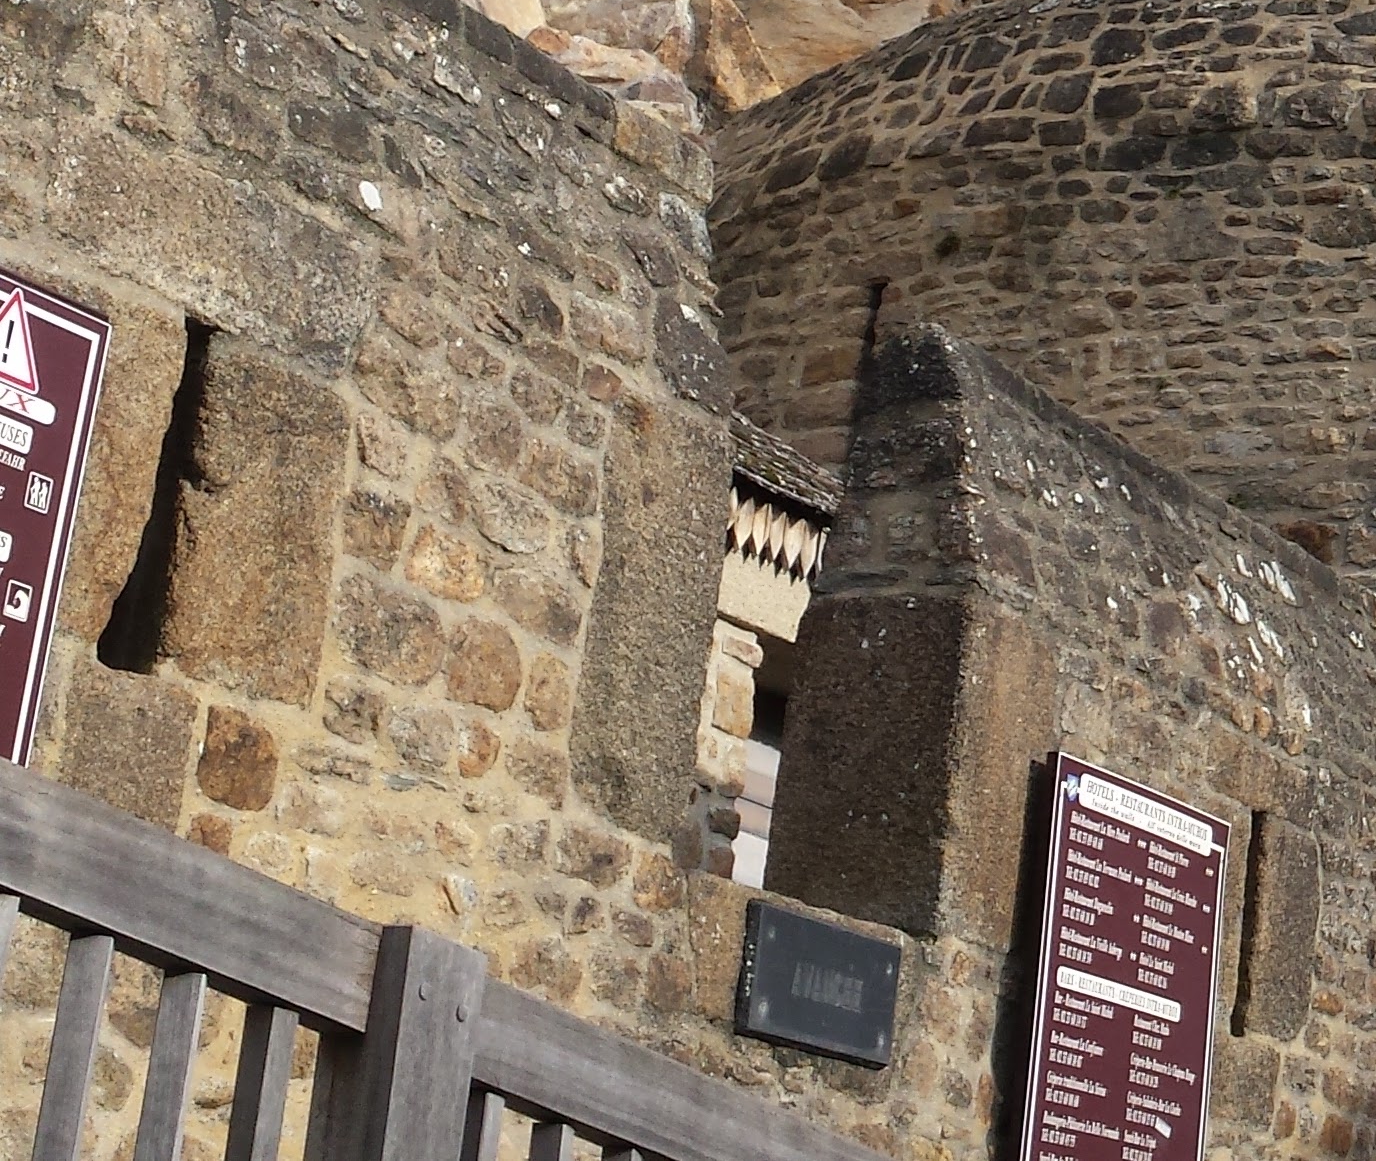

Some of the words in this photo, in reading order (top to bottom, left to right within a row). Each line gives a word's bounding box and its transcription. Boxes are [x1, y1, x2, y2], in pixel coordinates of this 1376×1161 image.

[0, 421, 28, 447] USES
[1086, 780, 1114, 802] HOTELS
[1119, 793, 1166, 823] RESTAURANTS
